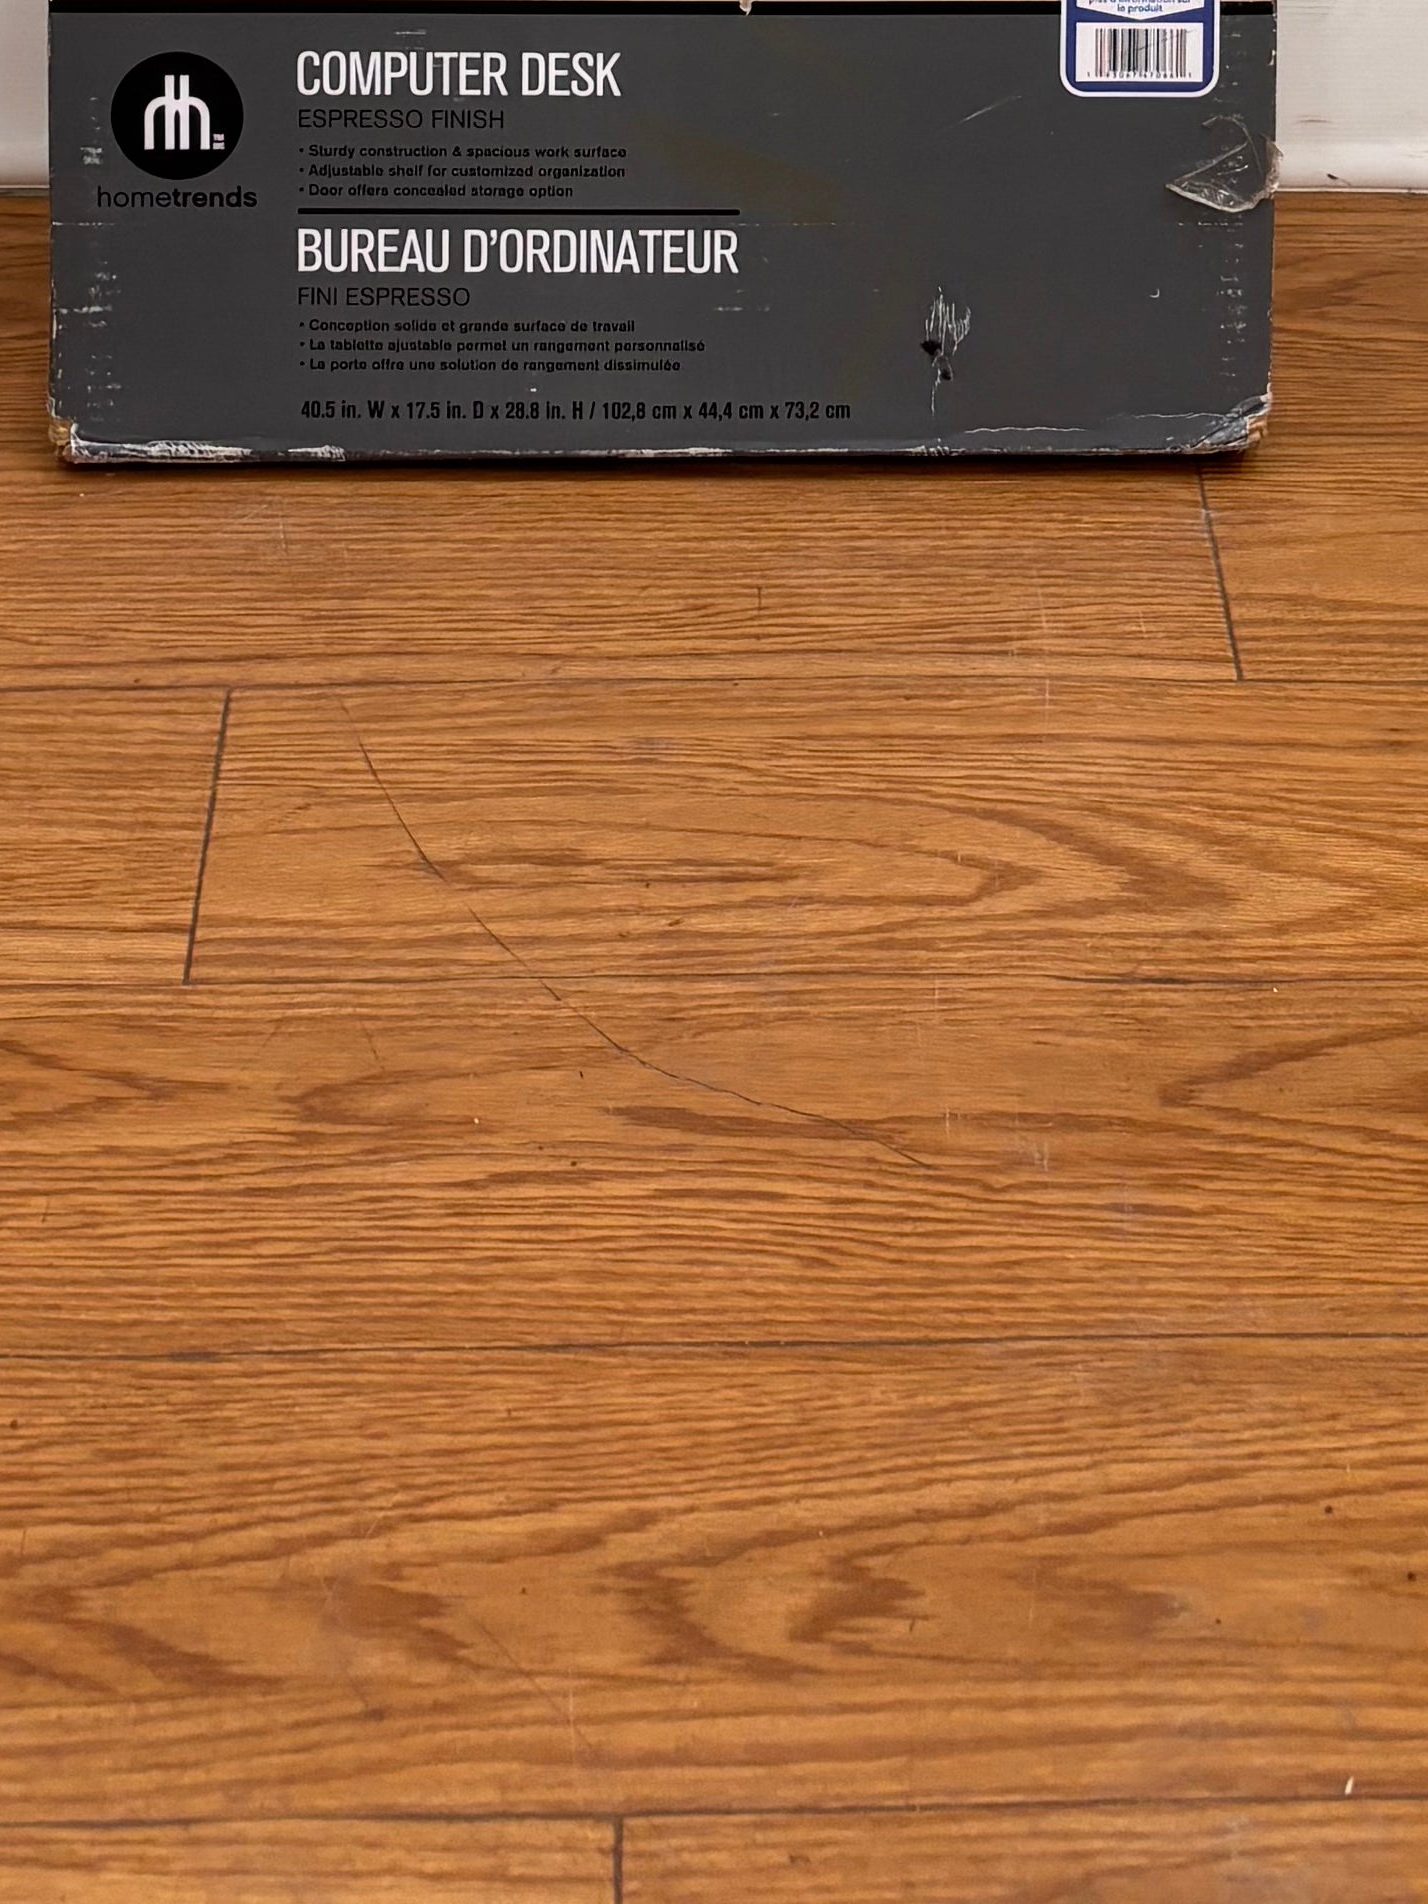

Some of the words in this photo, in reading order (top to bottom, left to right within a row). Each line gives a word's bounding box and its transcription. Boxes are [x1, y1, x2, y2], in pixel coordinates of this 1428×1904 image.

[1128, 4, 1162, 14] produit
[297, 51, 508, 96] COMPUTER
[522, 52, 621, 97] DESK
[298, 109, 423, 129] ESPRESSO
[431, 109, 504, 129] FINISH
[309, 145, 355, 159] Sturdy
[360, 146, 447, 156] construction
[452, 146, 461, 156] &
[467, 146, 530, 159] spacious
[535, 146, 570, 157] work
[574, 146, 627, 157] surface
[309, 164, 383, 178] Adjustable
[388, 164, 423, 176] shelf
[427, 164, 447, 176] for
[452, 166, 533, 177] customized
[538, 166, 625, 179] organization
[97, 185, 257, 208] hometrends
[309, 184, 343, 196] Door
[348, 184, 388, 196] offers
[394, 184, 466, 196] concealed
[471, 186, 524, 198] storage
[529, 186, 573, 198] option
[297, 228, 450, 273] BUREAU
[464, 228, 739, 273] D'ORDINATEUR
[298, 287, 338, 306] FINI
[346, 287, 470, 306] ESPRESSO
[309, 319, 389, 332] Conception
[394, 319, 436, 331] solide
[441, 321, 455, 331] et
[459, 320, 509, 333] grande
[514, 320, 566, 331] surface
[571, 320, 587, 331] de
[593, 320, 635, 331] travail
[310, 339, 325, 350] La
[330, 339, 383, 350] tablette
[388, 339, 451, 352] ajustable
[457, 340, 506, 352] permet
[512, 343, 528, 351] un
[534, 341, 610, 353] rangement
[615, 340, 705, 353] personnalisé
[310, 358, 325, 370] La
[331, 359, 367, 372] porte
[372, 358, 404, 370] offre
[409, 362, 435, 370] une
[440, 358, 496, 370] solution
[501, 360, 518, 371] de
[523, 360, 599, 372] rangement
[604, 359, 680, 371] dissimulée
[301, 401, 335, 419] 40.5
[341, 401, 361, 419] in.
[368, 401, 385, 419] W
[391, 405, 400, 418] x
[407, 401, 440, 419] 17.5
[447, 401, 466, 419] in.
[473, 401, 483, 419] D
[490, 405, 499, 419] x
[505, 401, 539, 419] 28.8
[546, 401, 565, 419] in.
[572, 401, 583, 419] H
[603, 402, 646, 422] 102,8
[652, 404, 676, 419] cm
[683, 405, 692, 419] x
[698, 402, 732, 421] 44,4
[738, 404, 763, 419] cm
[770, 405, 779, 419] x
[785, 402, 819, 421] 73,2
[826, 404, 850, 419] cm
